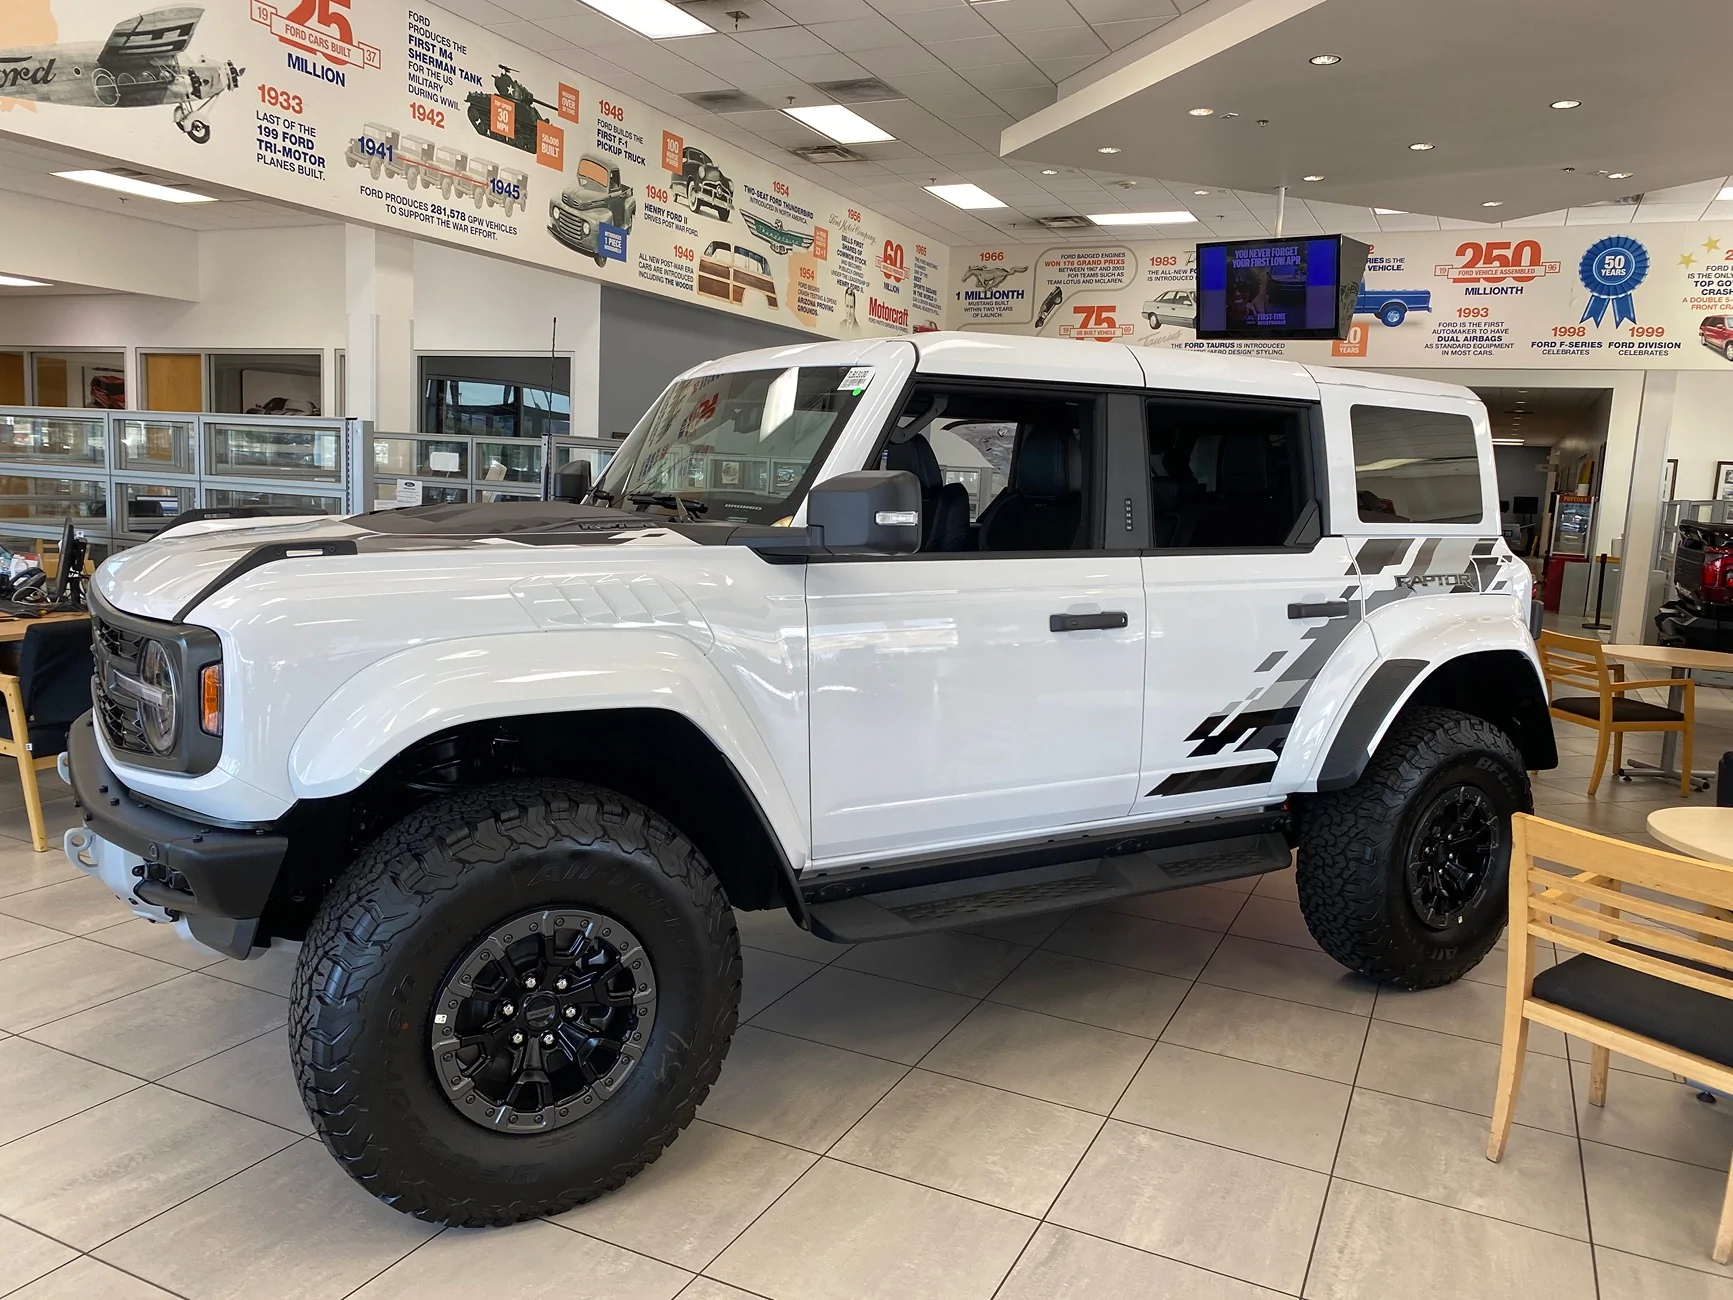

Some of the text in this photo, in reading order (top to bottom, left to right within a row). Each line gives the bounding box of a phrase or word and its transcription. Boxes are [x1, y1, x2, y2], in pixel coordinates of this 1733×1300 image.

[257, 6, 268, 20] 19
[408, 10, 430, 27] FORD
[285, 24, 351, 58] FORD CARS BUILT
[408, 22, 467, 55] PRODUCES THE
[408, 34, 453, 62] FIRST M4
[366, 49, 377, 63] 37
[287, 52, 345, 87] MILLION
[408, 48, 483, 87] SHERMAN TANK
[408, 61, 454, 86] FOR THE US
[408, 72, 444, 93] MILITARY
[257, 84, 303, 114] 1933
[408, 84, 438, 103] DURING
[561, 97, 576, 110] OVER
[409, 102, 445, 129] 1942
[497, 108, 509, 123] 30
[599, 100, 624, 122] 1948
[256, 110, 316, 137] LAST OF THE
[496, 122, 509, 133] MPH
[597, 119, 644, 144] FORD BUILDS THE
[257, 125, 315, 150] 199 FORD
[597, 128, 628, 148] FIRST F-1
[667, 138, 679, 154] 100
[256, 138, 326, 168] TRI-MOTOR
[358, 136, 393, 162] 1941
[541, 142, 560, 158] BUILT
[597, 140, 646, 166] PICKUP TRUCK
[256, 153, 326, 181] PLANES BUILT.
[490, 177, 520, 200] 1945
[646, 185, 668, 203] 1949
[773, 181, 789, 198] 1954
[360, 185, 518, 236] FORD PRODUCES 281,578 GPW VEHICLES
[644, 203, 666, 217] HENRY
[666, 210, 682, 223] FORD
[386, 204, 498, 241] TO SUPPORT THE WAR EFFORT.
[644, 213, 662, 225] DRIVES
[662, 219, 674, 229] POST
[675, 224, 686, 233] WAR
[674, 244, 694, 262] 1949
[883, 240, 904, 283] 60
[979, 252, 1004, 261] 1966
[1149, 256, 1177, 267] 1983
[1232, 255, 1301, 269] YOUR FIRST LOW APR
[1235, 246, 1299, 259] YOU NEVER FORGET
[1452, 240, 1542, 283] 250
[1604, 255, 1625, 269] 50
[799, 266, 815, 281] 1954
[1368, 264, 1404, 272] VEHICLE.
[1601, 268, 1626, 276] YEARS
[956, 290, 1025, 300] 1 MILLIONTH
[1465, 286, 1524, 295] MILLIONTH
[869, 297, 909, 327] Motorcraft
[1457, 307, 1489, 318] 1993
[1073, 305, 1117, 342] 75
[1552, 326, 1586, 337] 1998
[1629, 327, 1665, 337] 1999
[1394, 573, 1476, 594] RAPTOR
